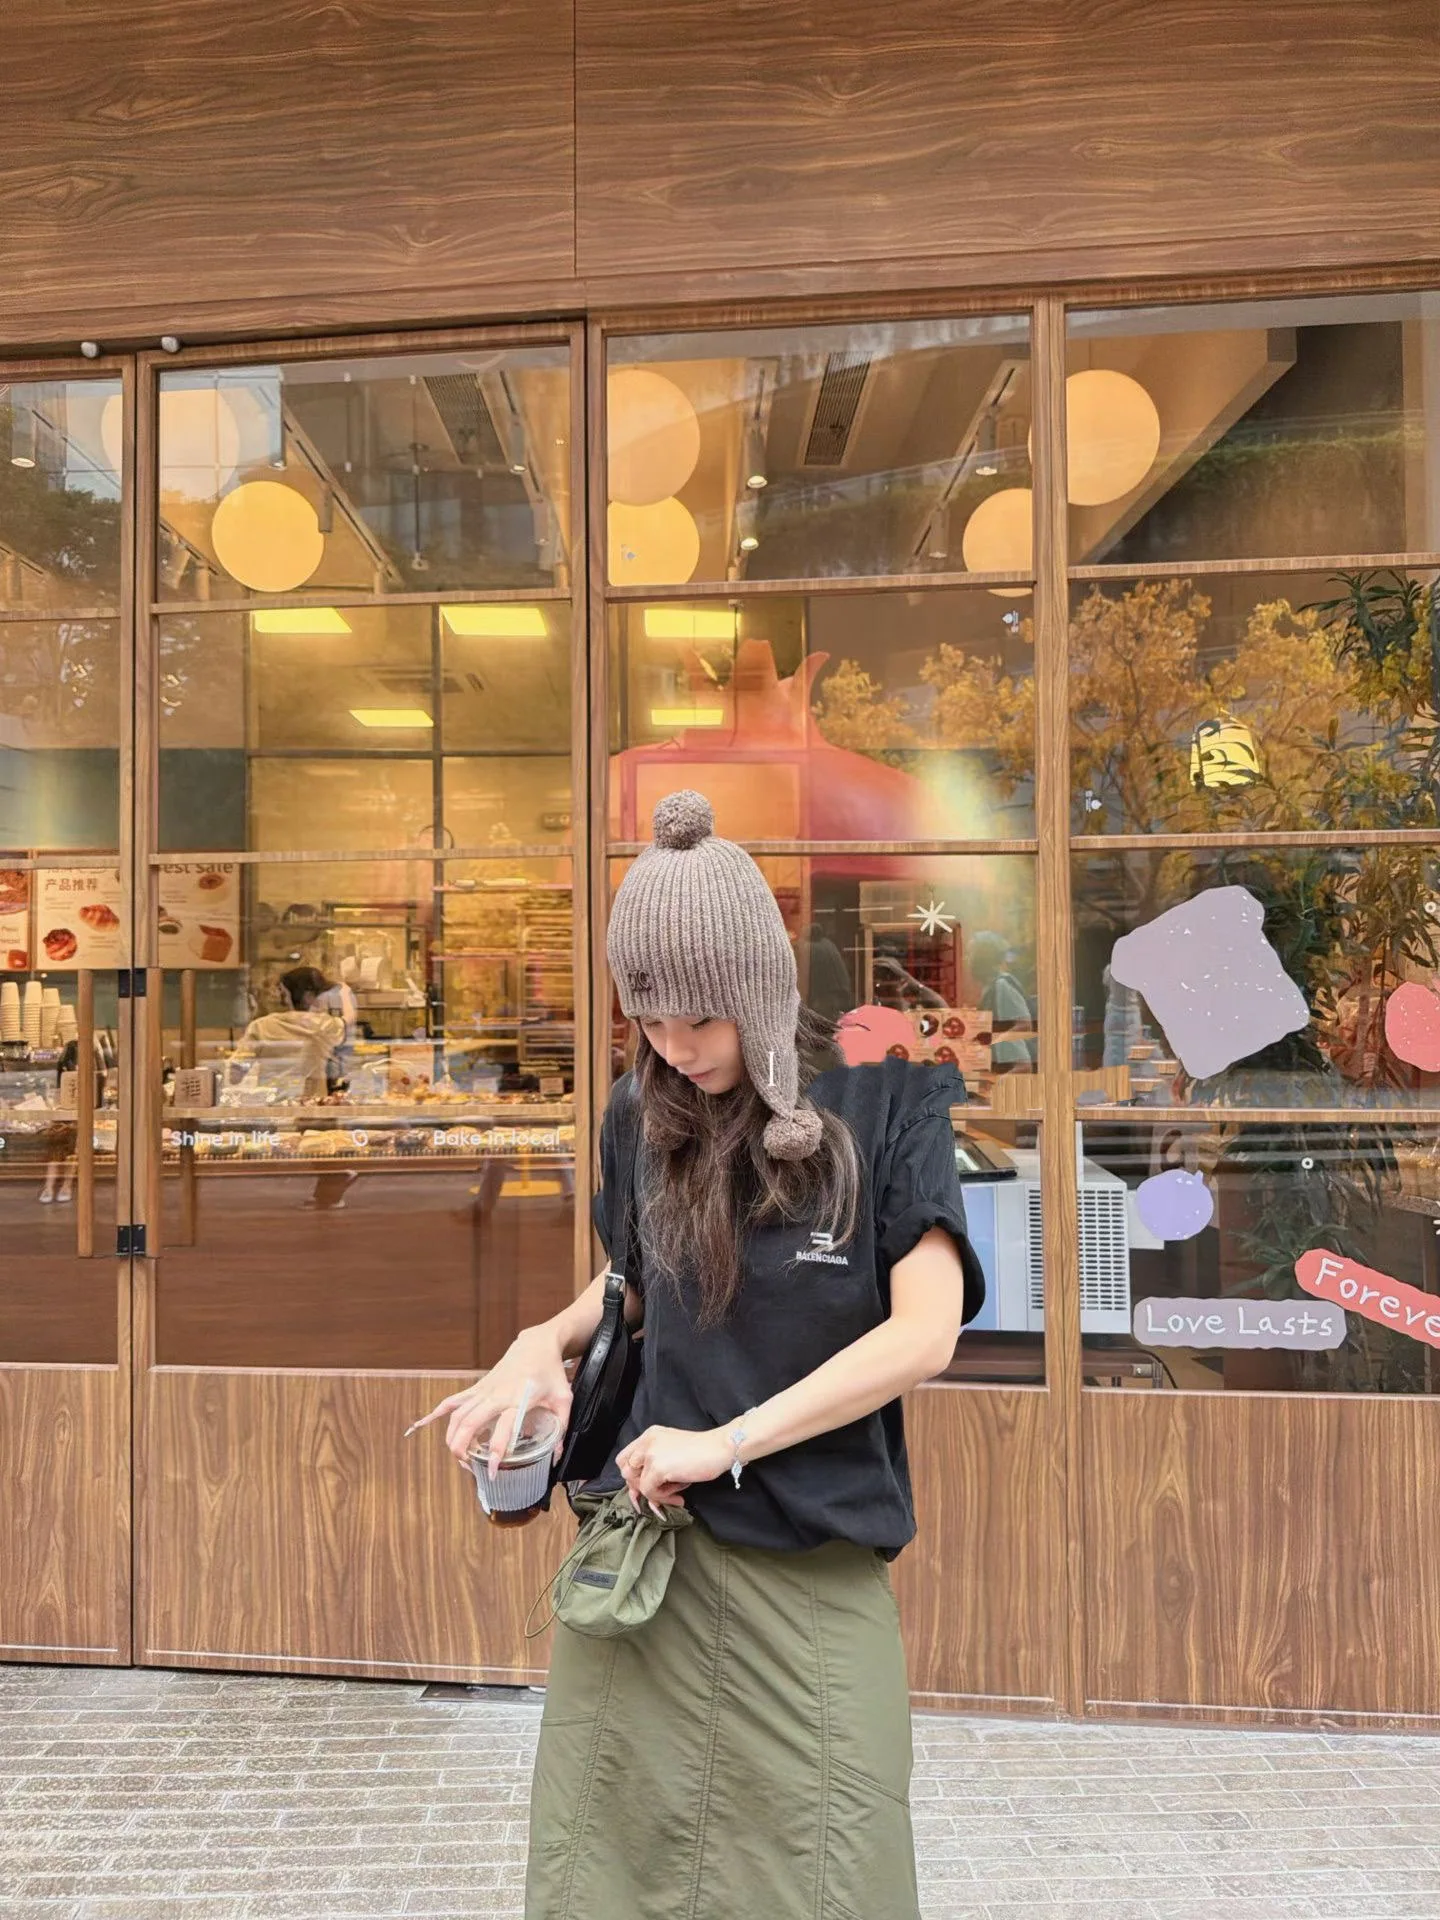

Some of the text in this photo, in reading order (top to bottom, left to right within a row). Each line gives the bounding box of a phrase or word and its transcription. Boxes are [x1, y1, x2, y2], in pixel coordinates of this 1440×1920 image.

[45, 878, 97, 892] 产品推荐
[171, 1130, 280, 1146] Shine in life
[433, 1129, 560, 1146] Bake in local
[795, 1250, 849, 1266] BALENCIAGA
[1146, 1304, 1333, 1336] Love Lasts
